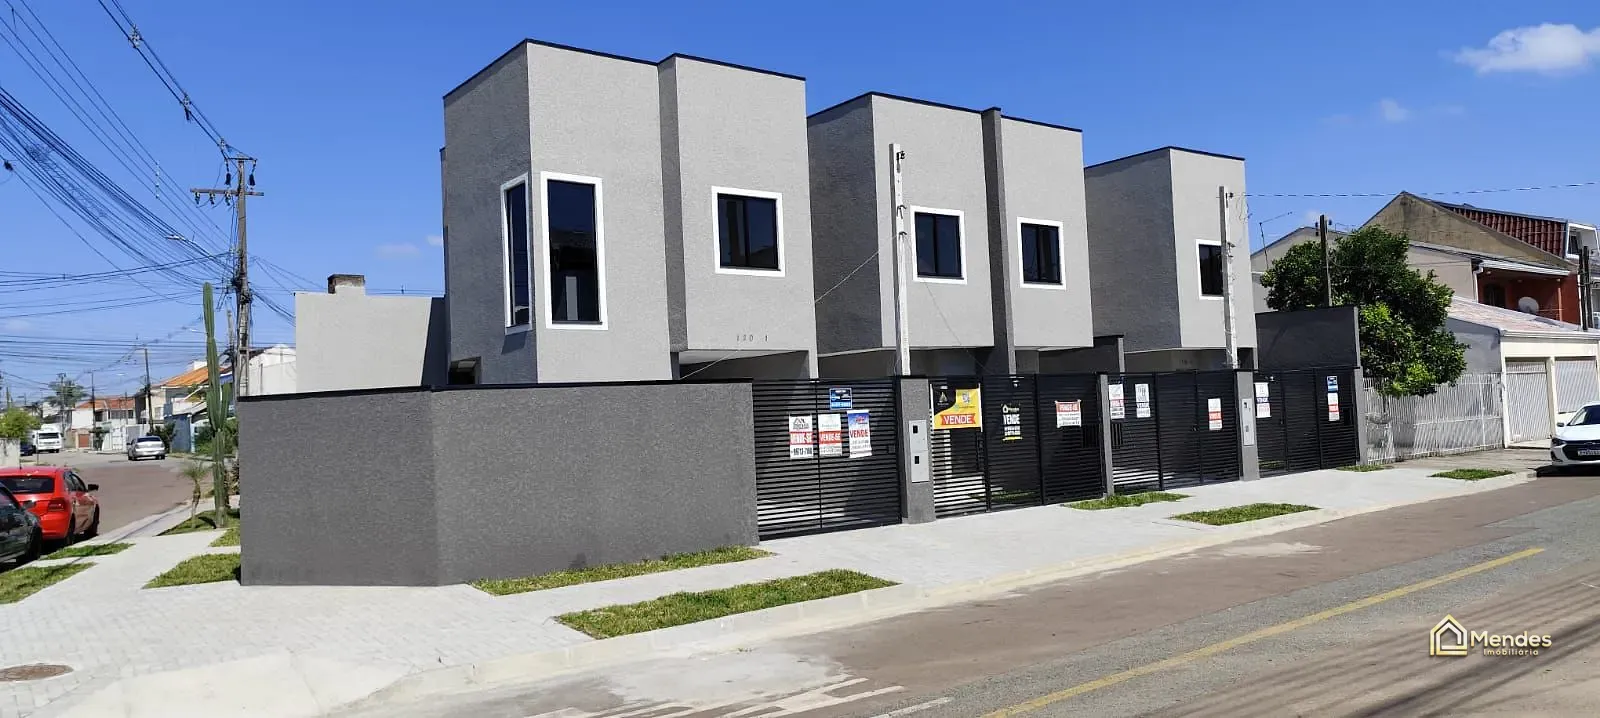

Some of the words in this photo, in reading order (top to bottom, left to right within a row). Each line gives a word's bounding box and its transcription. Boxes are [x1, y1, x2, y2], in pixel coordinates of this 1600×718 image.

[943, 415, 972, 425] VENDE
[1003, 414, 1020, 424] VENDE
[849, 429, 869, 438] VENDE
